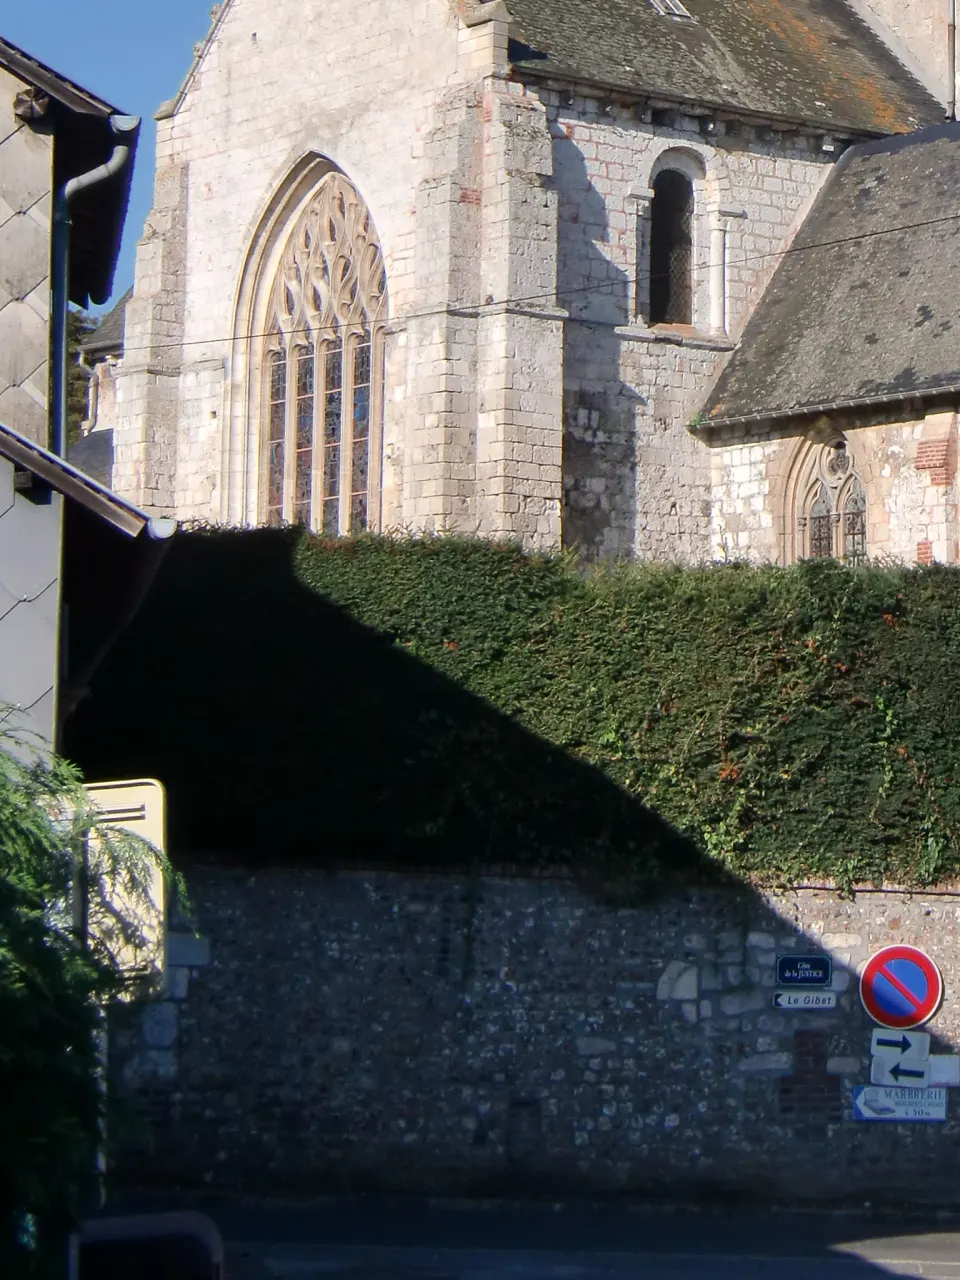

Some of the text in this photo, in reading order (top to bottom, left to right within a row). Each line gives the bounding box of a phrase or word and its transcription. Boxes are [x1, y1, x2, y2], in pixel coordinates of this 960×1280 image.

[784, 969, 791, 977] de
[798, 970, 823, 978] JUSTICE
[788, 996, 831, 1005] Le Gibet
[884, 1089, 944, 1100] MARBRERIE
